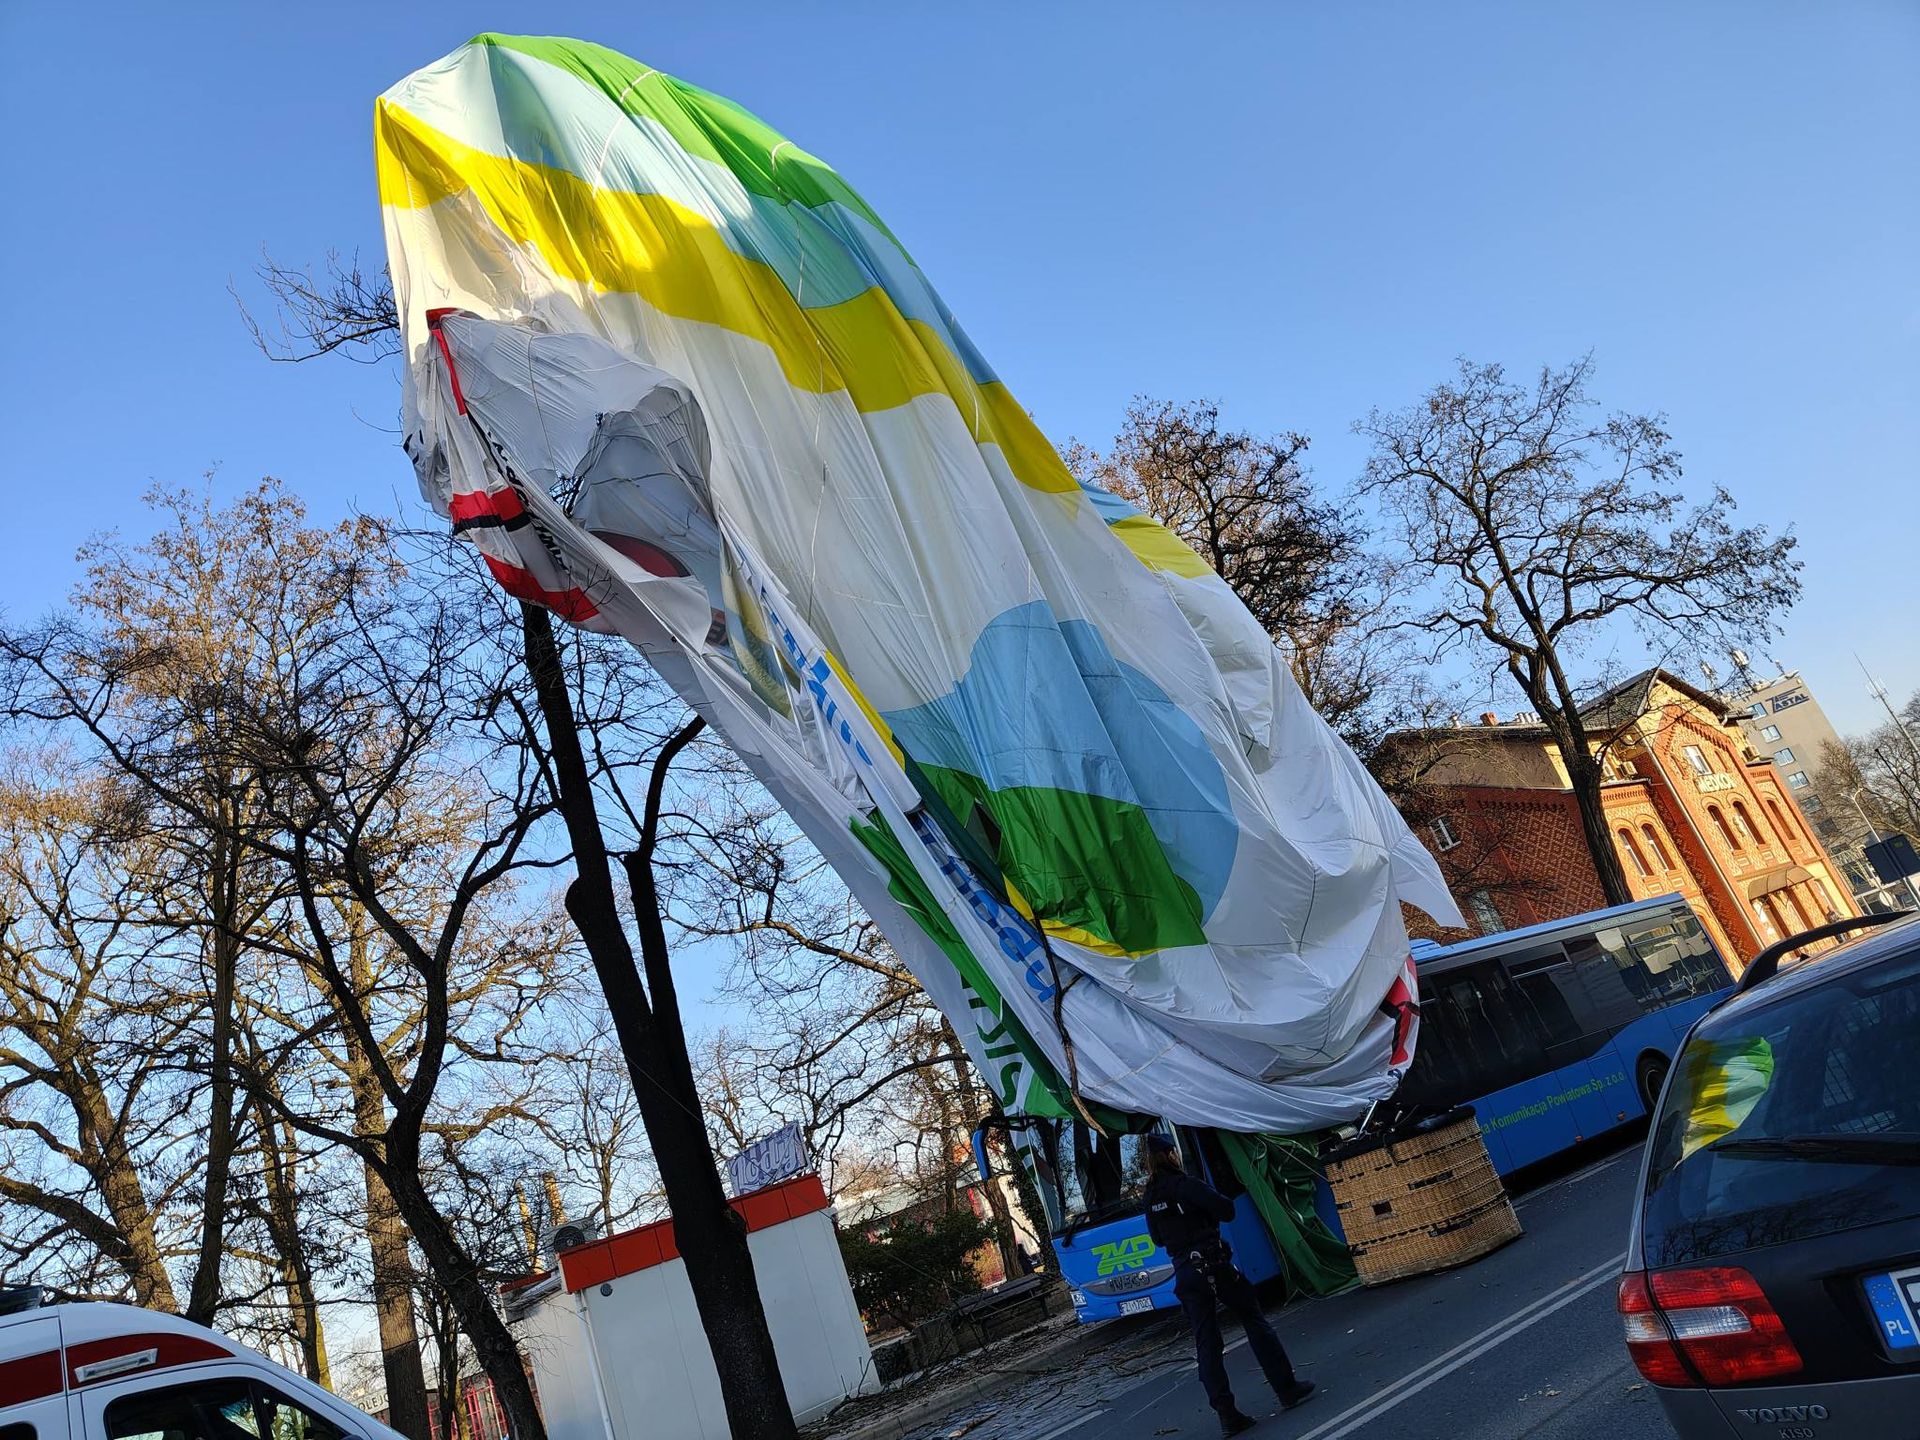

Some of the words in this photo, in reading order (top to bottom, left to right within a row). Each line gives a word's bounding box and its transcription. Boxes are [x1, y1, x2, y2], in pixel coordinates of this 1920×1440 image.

[1490, 1101, 1548, 1131] Komunikacja
[1547, 1083, 1591, 1109] Powiatowa
[1091, 1234, 1156, 1276] ZKP
[1109, 1272, 1150, 1292] IVECO
[1885, 1319, 1910, 1337] PL
[1736, 1404, 1828, 1424] VOLVO
